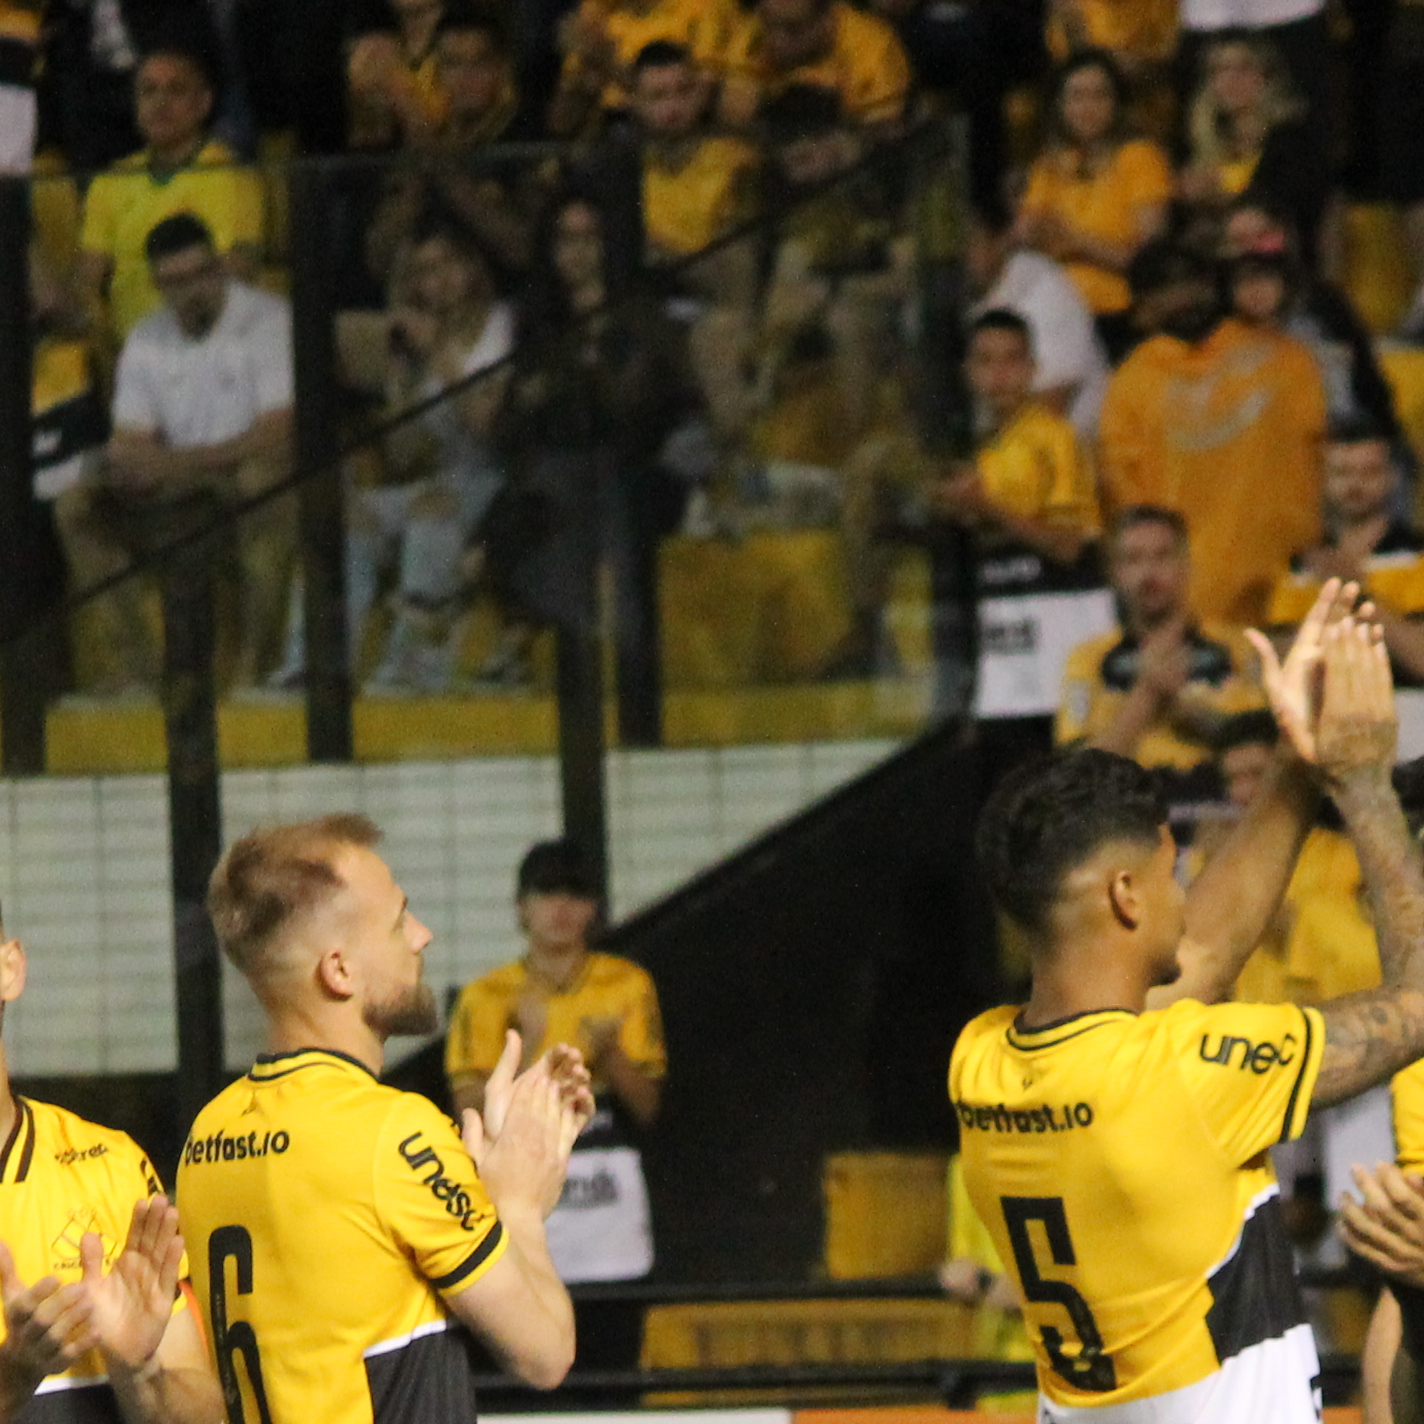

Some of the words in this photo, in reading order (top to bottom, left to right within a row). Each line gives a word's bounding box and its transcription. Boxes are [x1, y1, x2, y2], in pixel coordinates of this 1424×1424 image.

[957, 1102, 1094, 1133] betfast.io
[184, 1129, 290, 1168] betfast.io
[1000, 1196, 1117, 1391] 5
